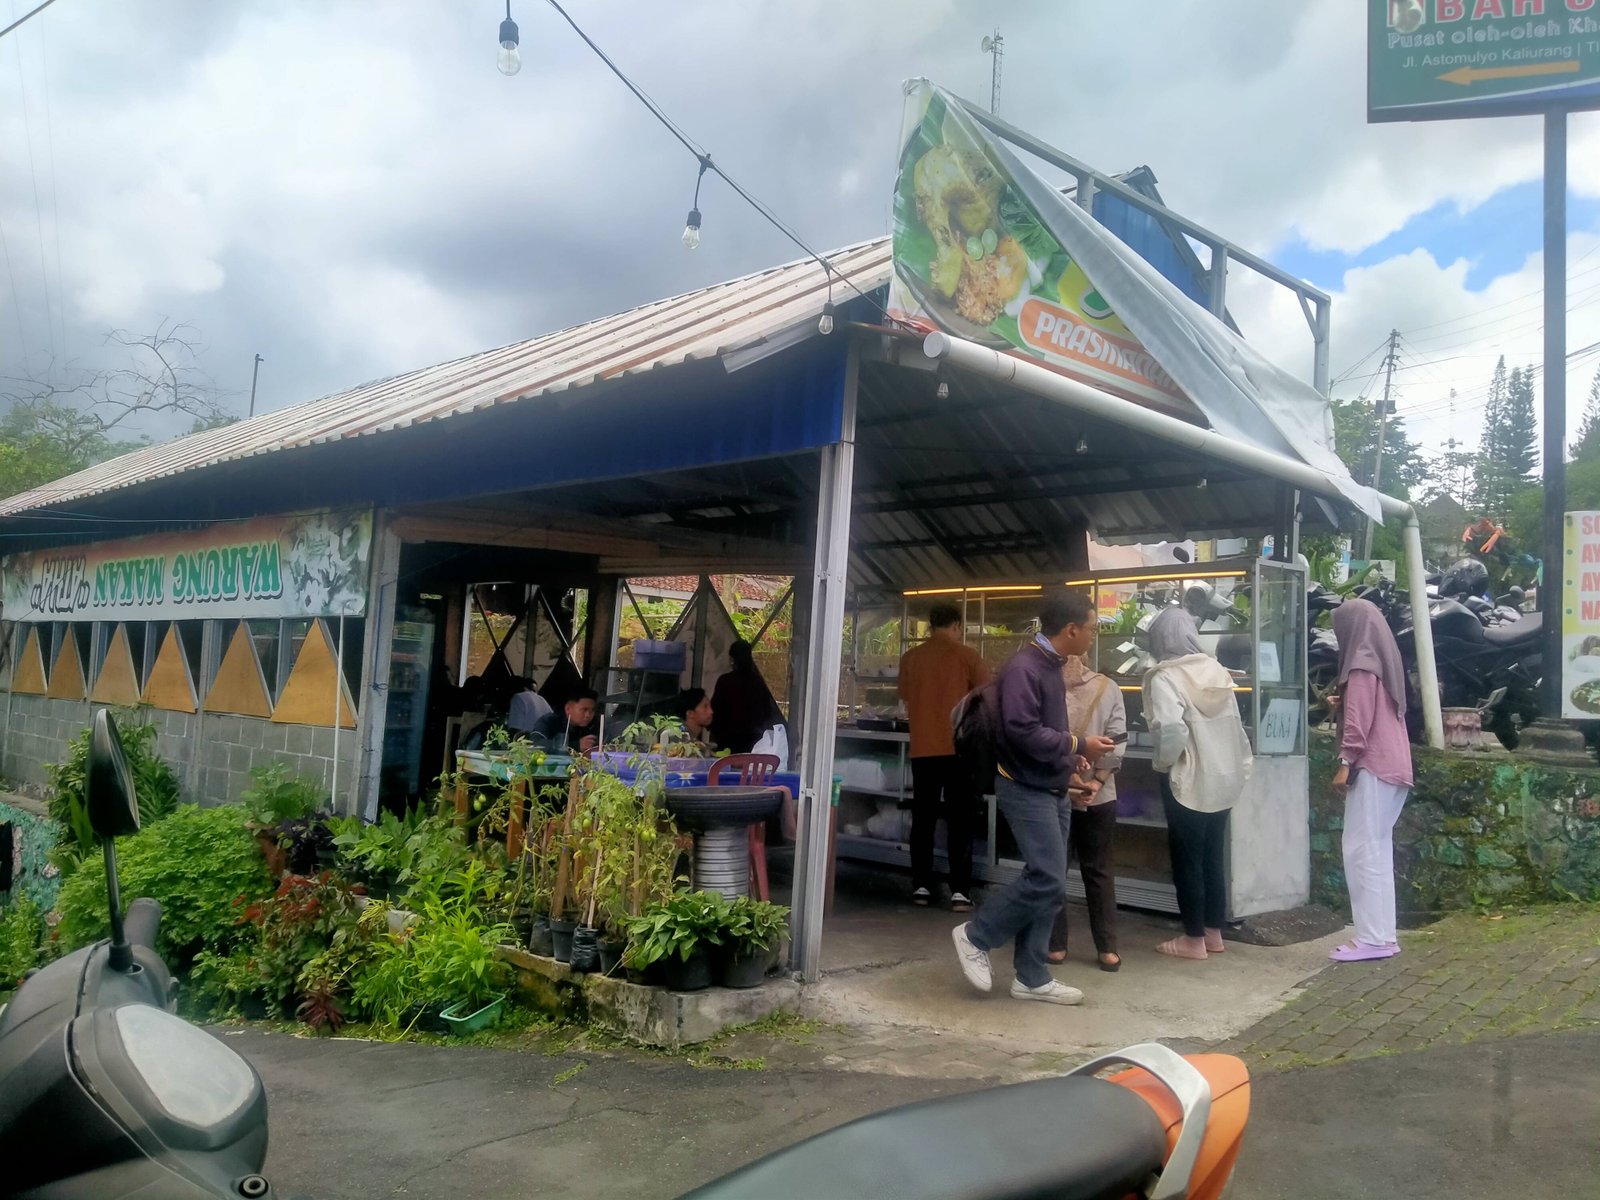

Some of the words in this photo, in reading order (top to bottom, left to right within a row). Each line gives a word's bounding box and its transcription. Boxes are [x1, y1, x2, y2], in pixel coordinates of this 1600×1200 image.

[1387, 0, 1545, 27] BAH
[1387, 30, 1445, 49] Pusat
[1451, 20, 1560, 44] oleh-oleh
[1421, 50, 1497, 67] Astomulyo
[1502, 46, 1572, 60] Kaliurang
[93, 554, 165, 607] MAKAN
[172, 541, 283, 604] WARUNG
